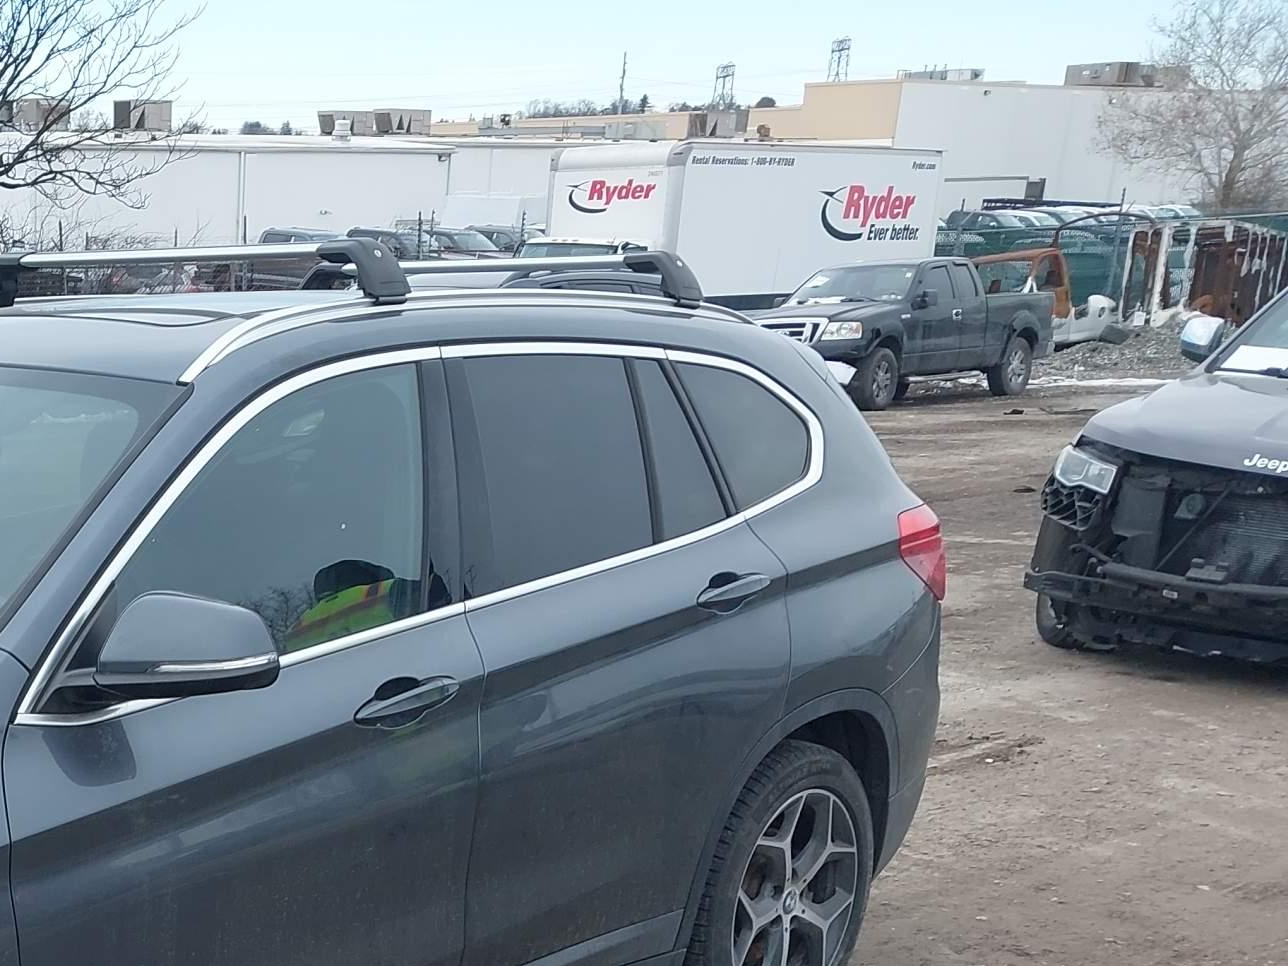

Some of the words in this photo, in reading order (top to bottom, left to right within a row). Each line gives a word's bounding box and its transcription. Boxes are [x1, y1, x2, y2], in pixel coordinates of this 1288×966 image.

[692, 156, 710, 165] Rental
[588, 179, 656, 205] Ryder
[843, 185, 916, 227] Ryder
[867, 224, 889, 240] Ever
[890, 224, 919, 241] better.
[1243, 454, 1288, 473] Jeep
